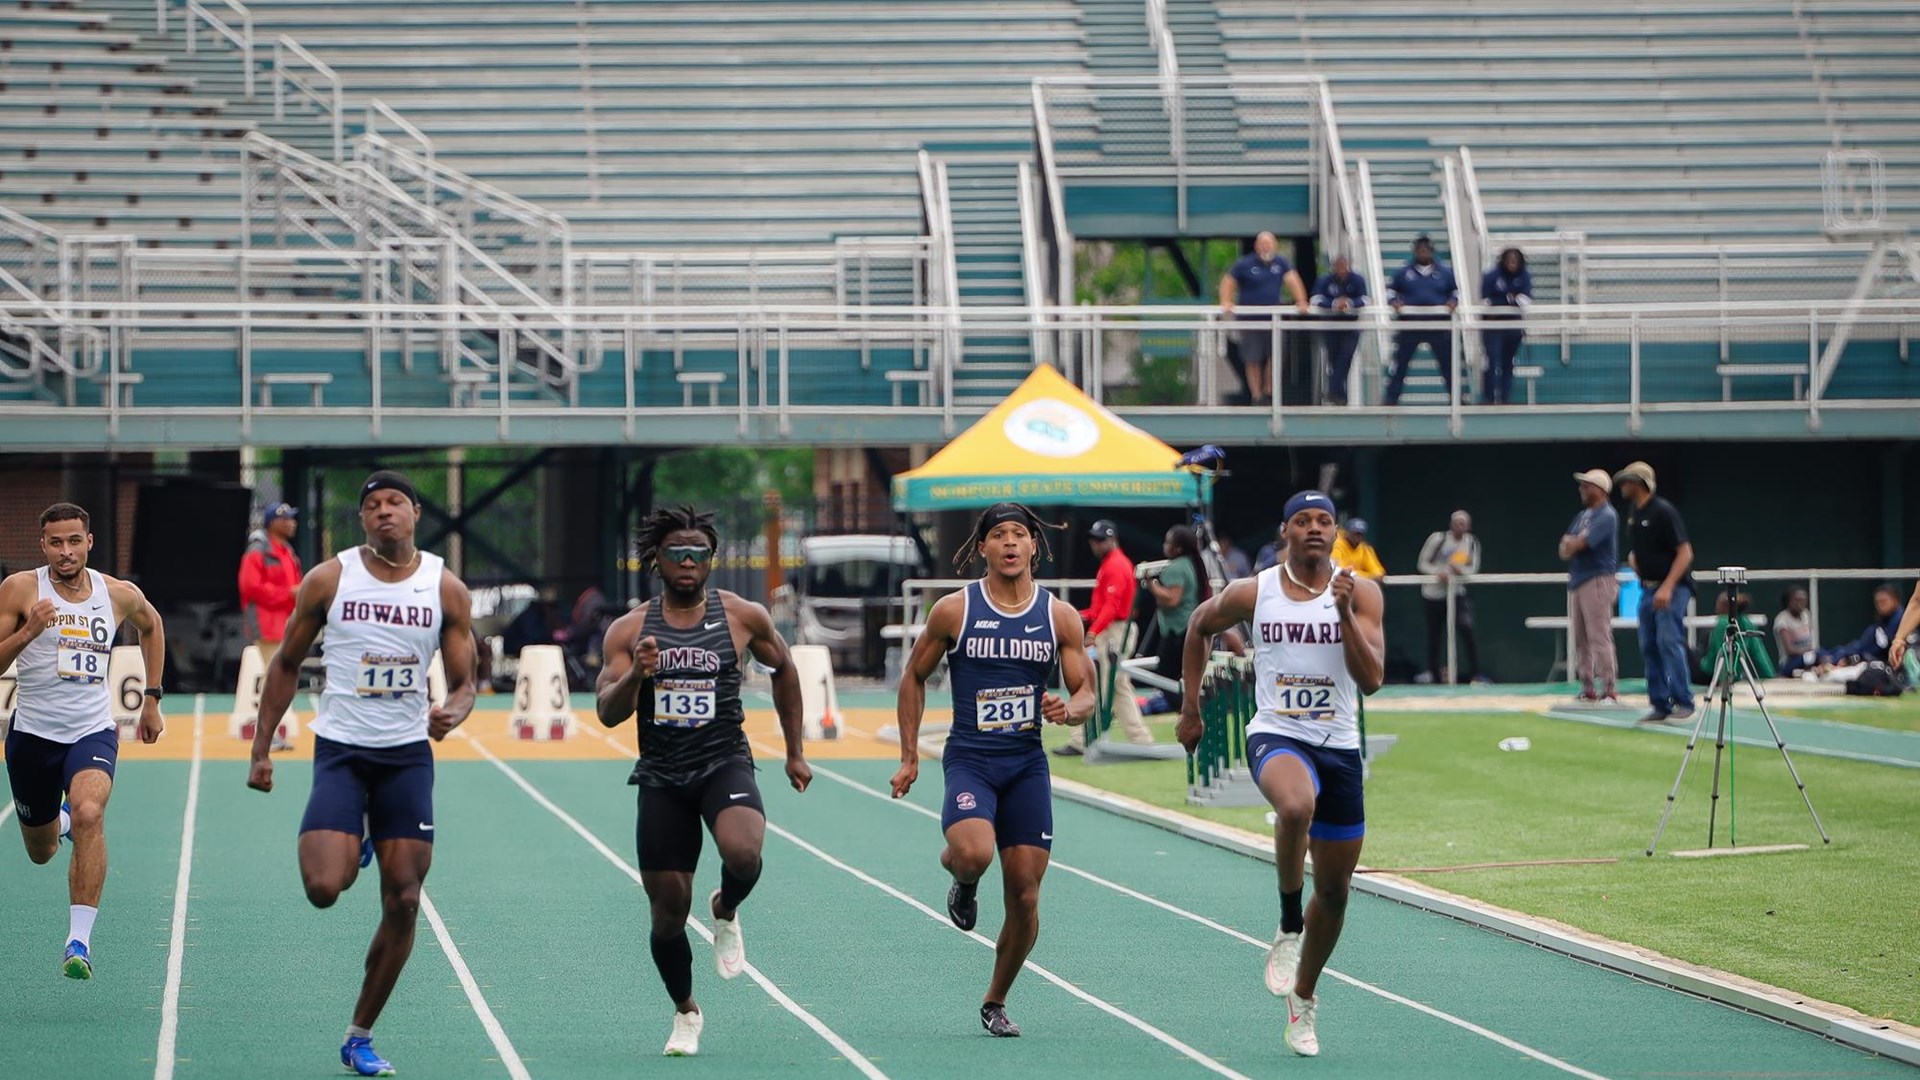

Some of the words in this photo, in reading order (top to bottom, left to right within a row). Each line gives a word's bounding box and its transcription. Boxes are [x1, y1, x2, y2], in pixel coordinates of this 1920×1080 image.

[1019, 480, 1073, 496] STATE
[1078, 479, 1183, 496] UNIVERSITY
[341, 601, 433, 628] HOWARD
[90, 616, 109, 643] 6
[966, 637, 1052, 663] BULLDOGS
[71, 652, 97, 673] 18
[363, 668, 413, 688] 113
[121, 676, 143, 711] 6
[550, 674, 565, 710] 3
[1281, 689, 1331, 709] 102
[660, 693, 710, 715] 135
[982, 700, 1027, 722] 281
